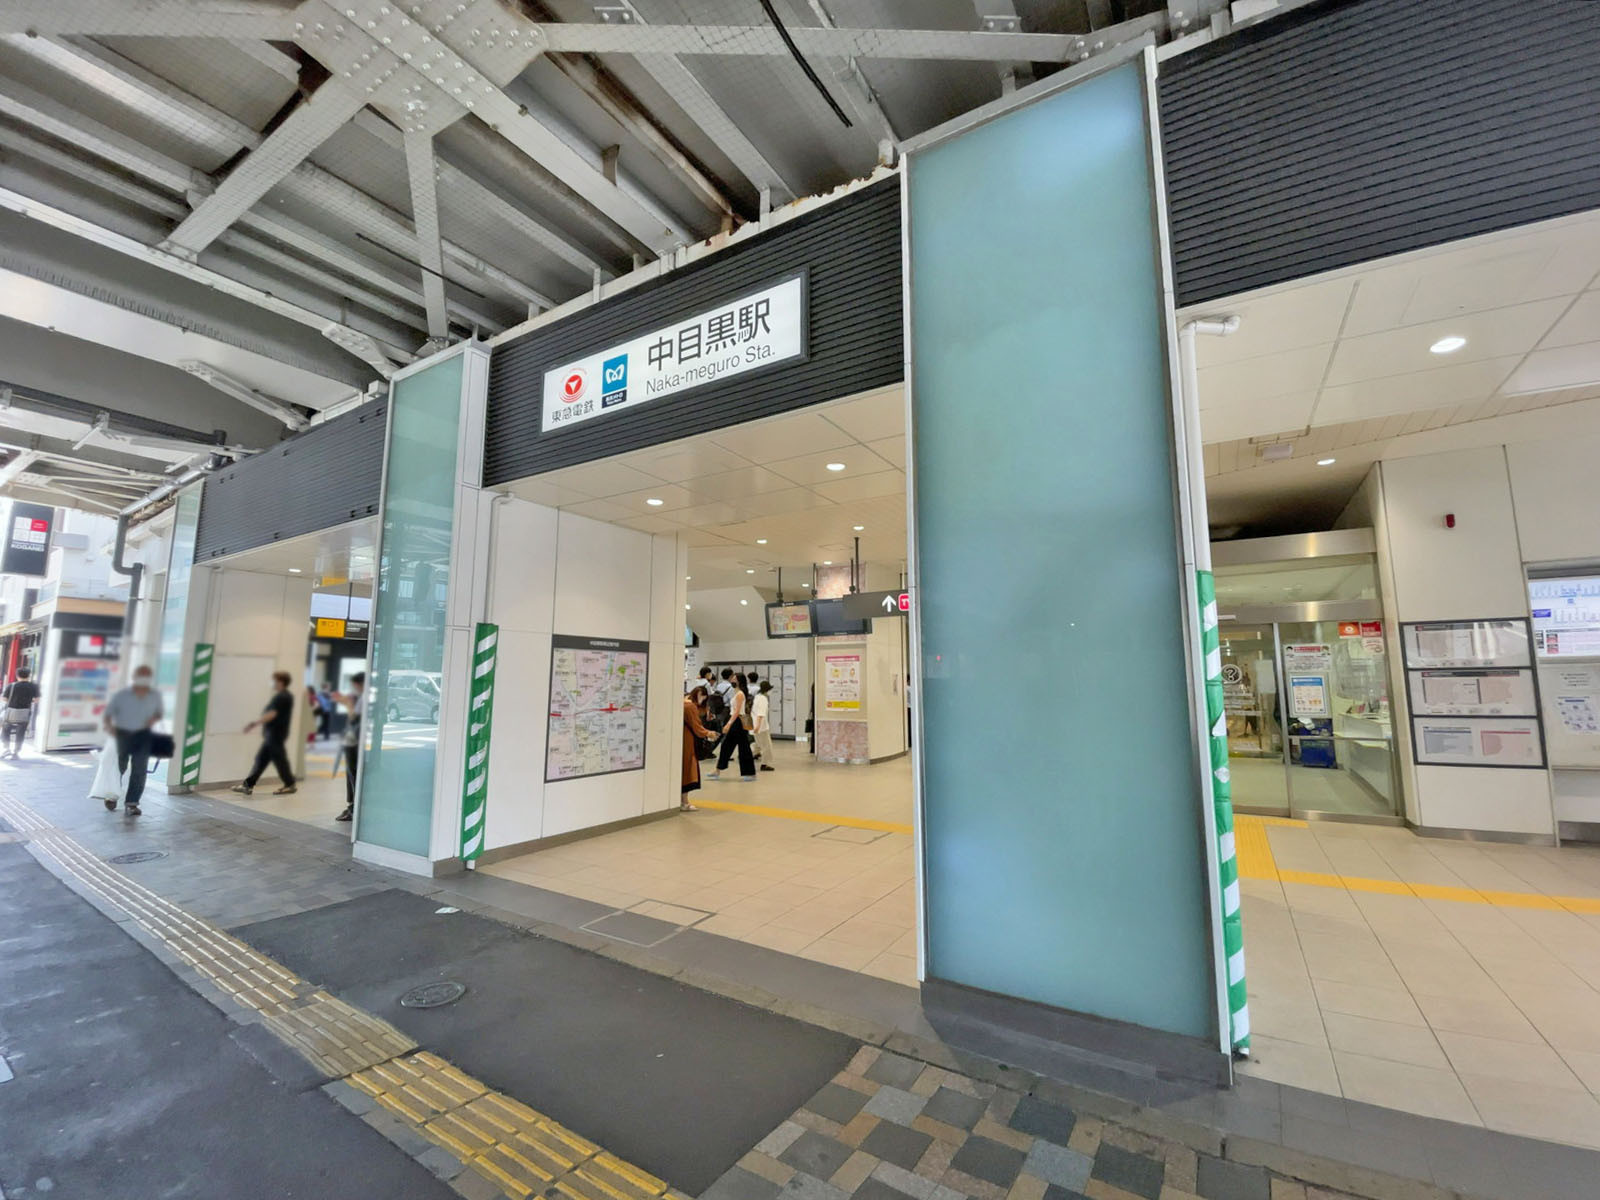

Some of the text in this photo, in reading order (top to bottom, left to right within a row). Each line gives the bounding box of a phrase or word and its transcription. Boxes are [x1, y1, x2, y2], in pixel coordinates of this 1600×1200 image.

[648, 297, 771, 371] 中目黒駅
[646, 344, 776, 395] Naka-meguro Sta.
[551, 399, 594, 424] 東急電鉄
